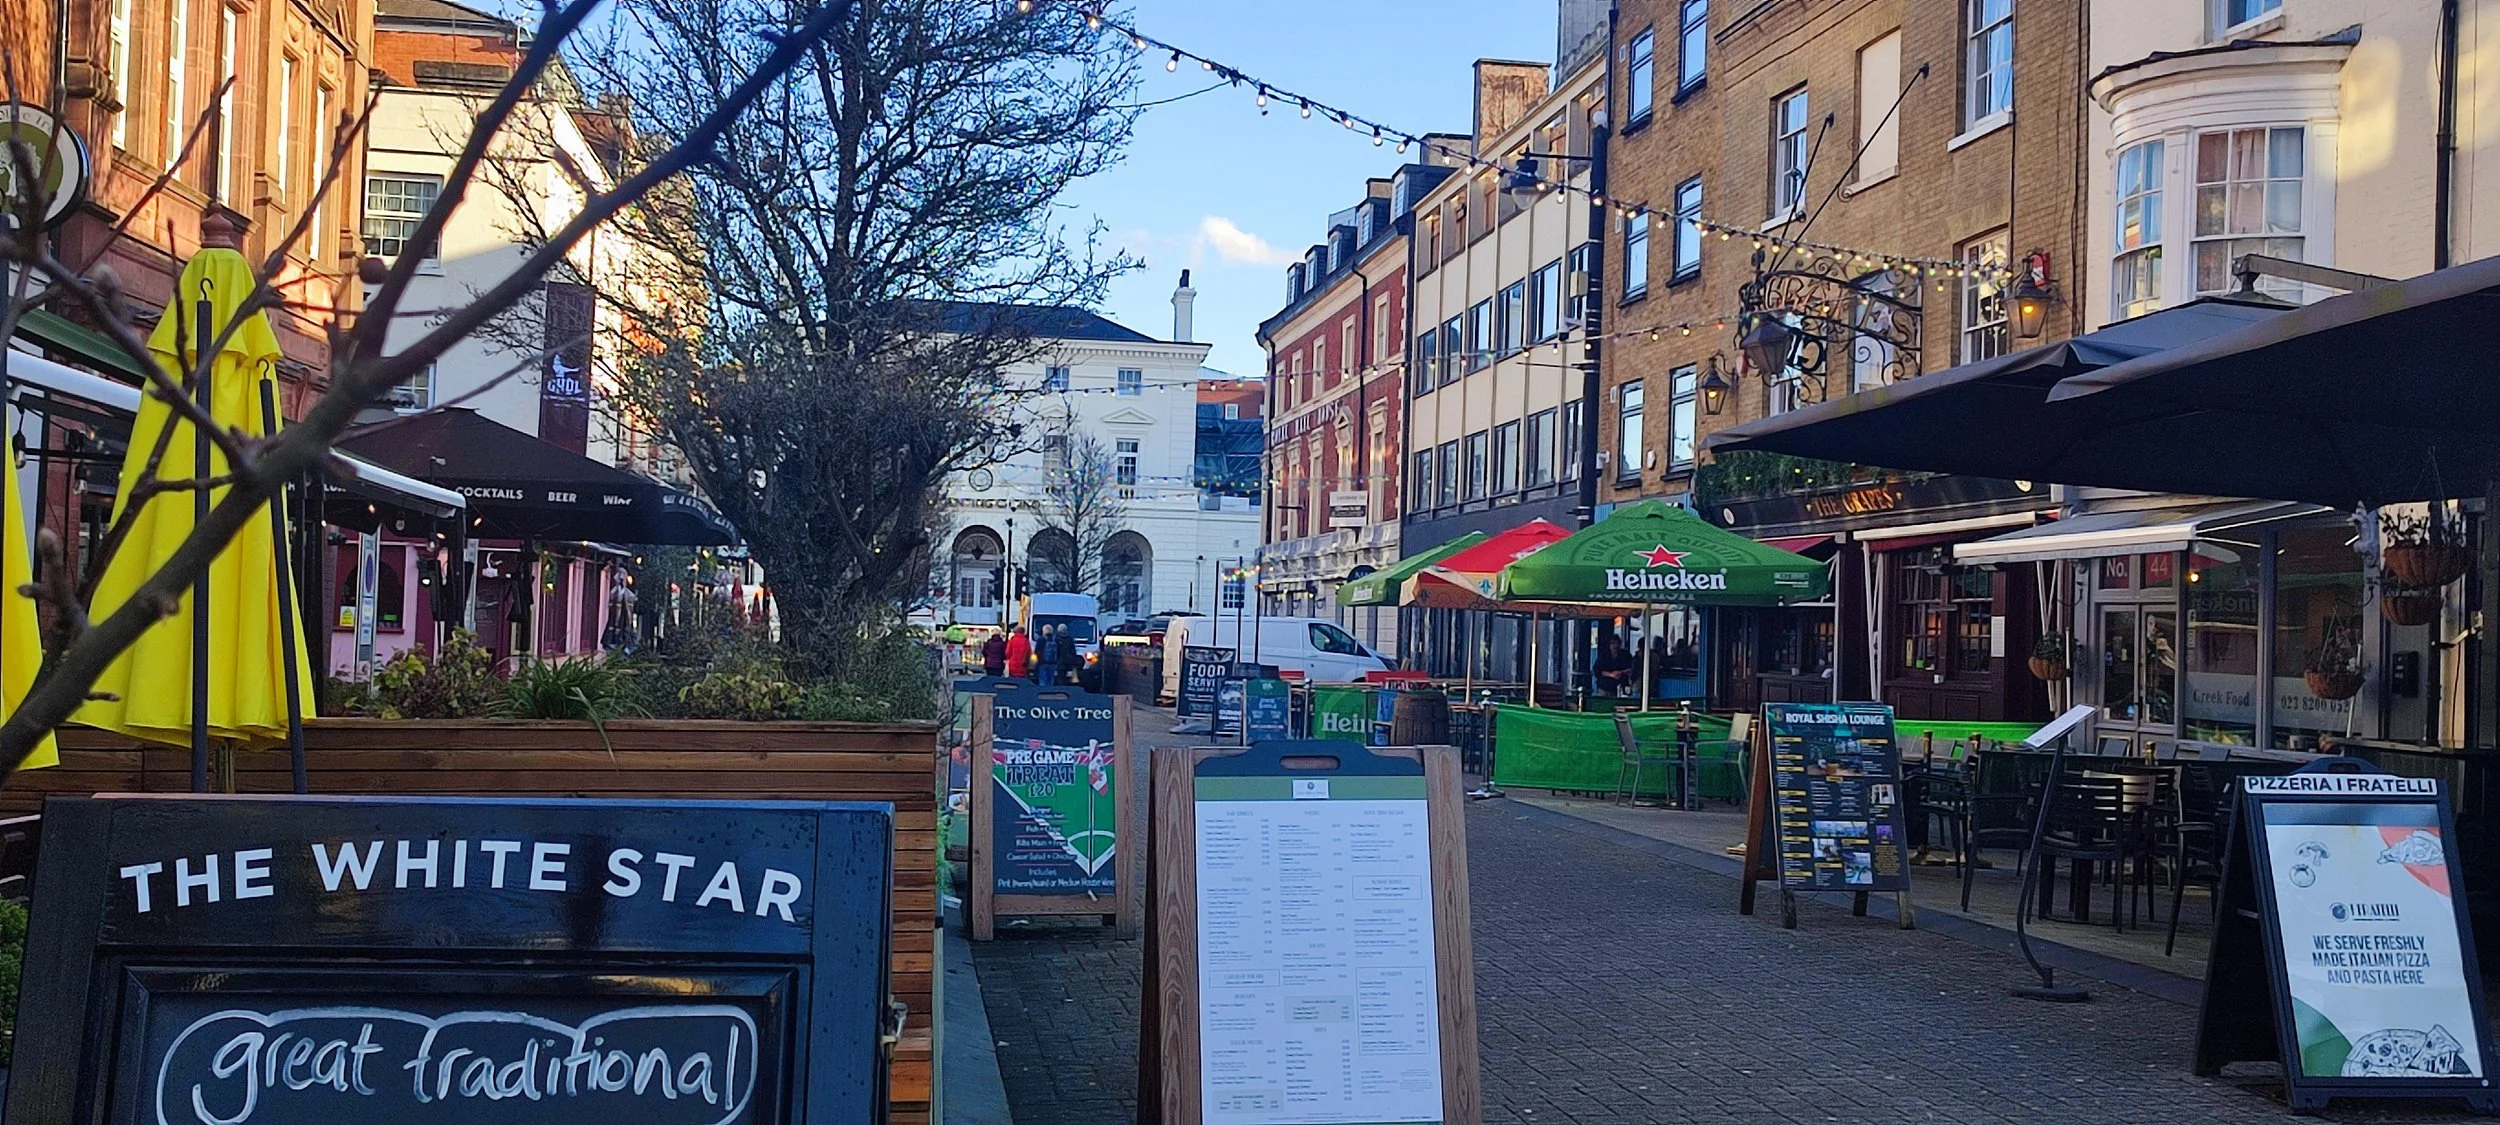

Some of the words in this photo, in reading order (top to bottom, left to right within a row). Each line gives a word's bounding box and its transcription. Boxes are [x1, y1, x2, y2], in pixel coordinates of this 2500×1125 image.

[455, 486, 524, 500] COCKTAILS
[548, 491, 578, 503] BEER
[1815, 498, 1840, 517] THE
[1842, 488, 1895, 515] GRAPES
[1583, 538, 1614, 562] PURE
[1614, 531, 1668, 548] MALT
[1677, 537, 1748, 564] QUALITY
[2106, 559, 2128, 578] No.
[2150, 559, 2168, 576] 44
[1605, 568, 1726, 590] Heineken
[2193, 689, 2223, 704] Greek
[2226, 691, 2251, 707] Food
[2280, 695, 2299, 711] 023
[2302, 696, 2327, 712] 8200
[995, 706, 1026, 719] The
[1030, 707, 1070, 719] Olive
[1074, 707, 1112, 719] Tree
[1785, 713, 1815, 724] ROYAL
[1816, 713, 1848, 725] SHISHA
[1850, 714, 1886, 726] LOUNGE
[1006, 750, 1033, 764] PRE
[1034, 750, 1075, 764] GAME
[1005, 764, 1075, 785] TREAT
[1028, 783, 1055, 797] £20
[2247, 777, 2330, 792] PIZZERIA
[2336, 778, 2342, 792] I
[2346, 778, 2434, 794] FRATELLI
[120, 846, 275, 913] THE
[311, 839, 572, 894] WHITE
[602, 847, 804, 923] STAR
[2313, 935, 2333, 950] WE
[2334, 935, 2372, 950] SERVE
[2374, 935, 2425, 951] FRESHLY
[2312, 952, 2348, 967] MADE
[2349, 952, 2394, 967] ITALIAN
[2396, 953, 2430, 968] PIZZA
[2328, 970, 2352, 984] AND
[2354, 970, 2392, 984] PASTA
[2393, 970, 2425, 984] HERE
[193, 1022, 384, 1125] great
[403, 1022, 741, 1112] traditional
